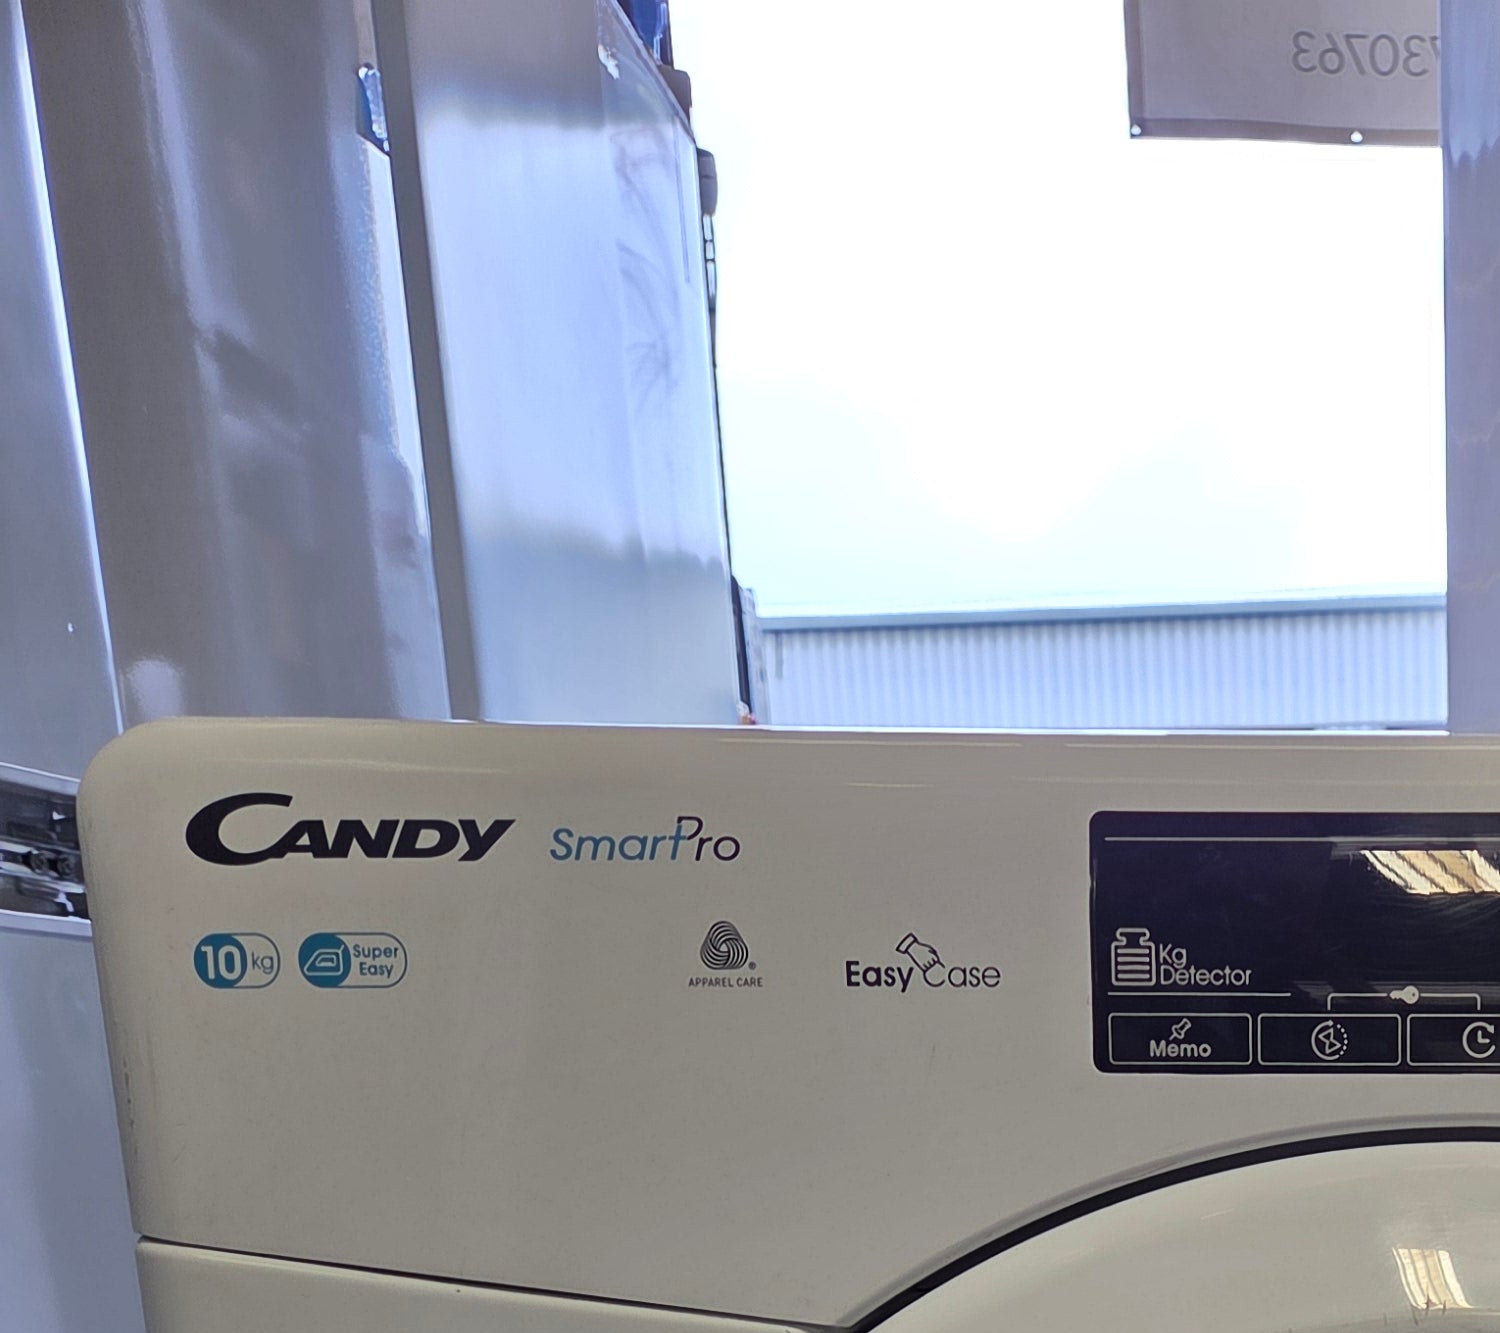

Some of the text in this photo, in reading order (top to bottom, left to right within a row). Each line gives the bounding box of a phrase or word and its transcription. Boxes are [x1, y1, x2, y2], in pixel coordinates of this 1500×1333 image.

[353, 944, 400, 960] Super
[1159, 943, 1187, 968] Kg
[201, 945, 275, 980] 10 kg
[359, 962, 394, 978] Easy
[688, 977, 763, 988] APPAREL CARE
[1160, 965, 1252, 985] Detector
[1150, 1039, 1212, 1057] Memo
